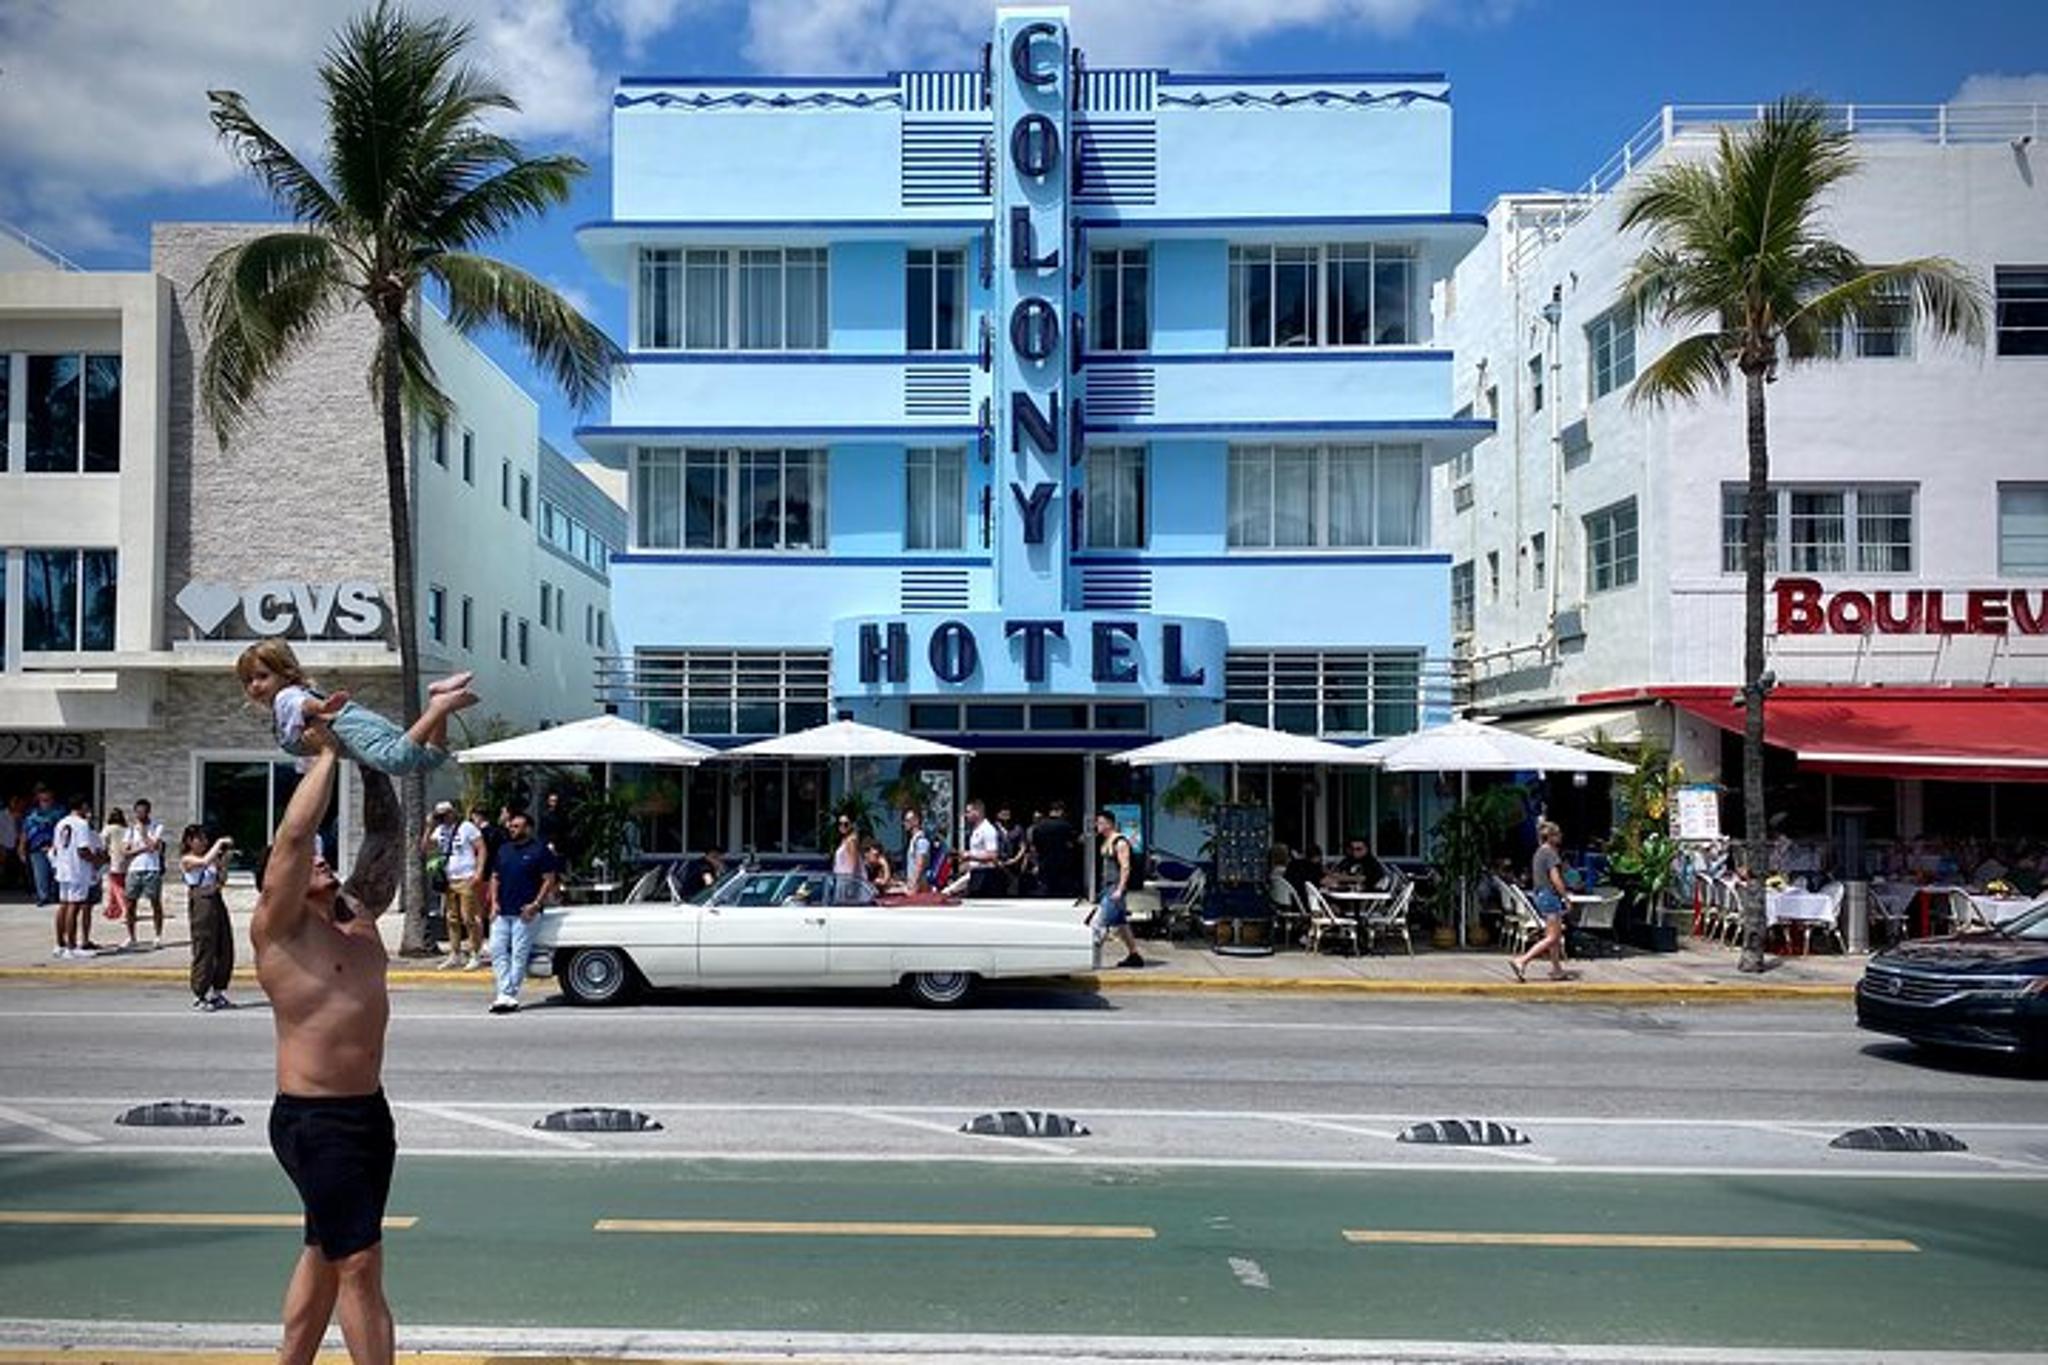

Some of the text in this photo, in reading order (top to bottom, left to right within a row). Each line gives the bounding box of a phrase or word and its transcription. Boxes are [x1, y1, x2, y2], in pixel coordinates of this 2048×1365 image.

[1009, 21, 1061, 545] COLONY
[243, 579, 384, 636] CVS
[858, 620, 1205, 686] HOTEL
[22, 735, 81, 759] CVS
